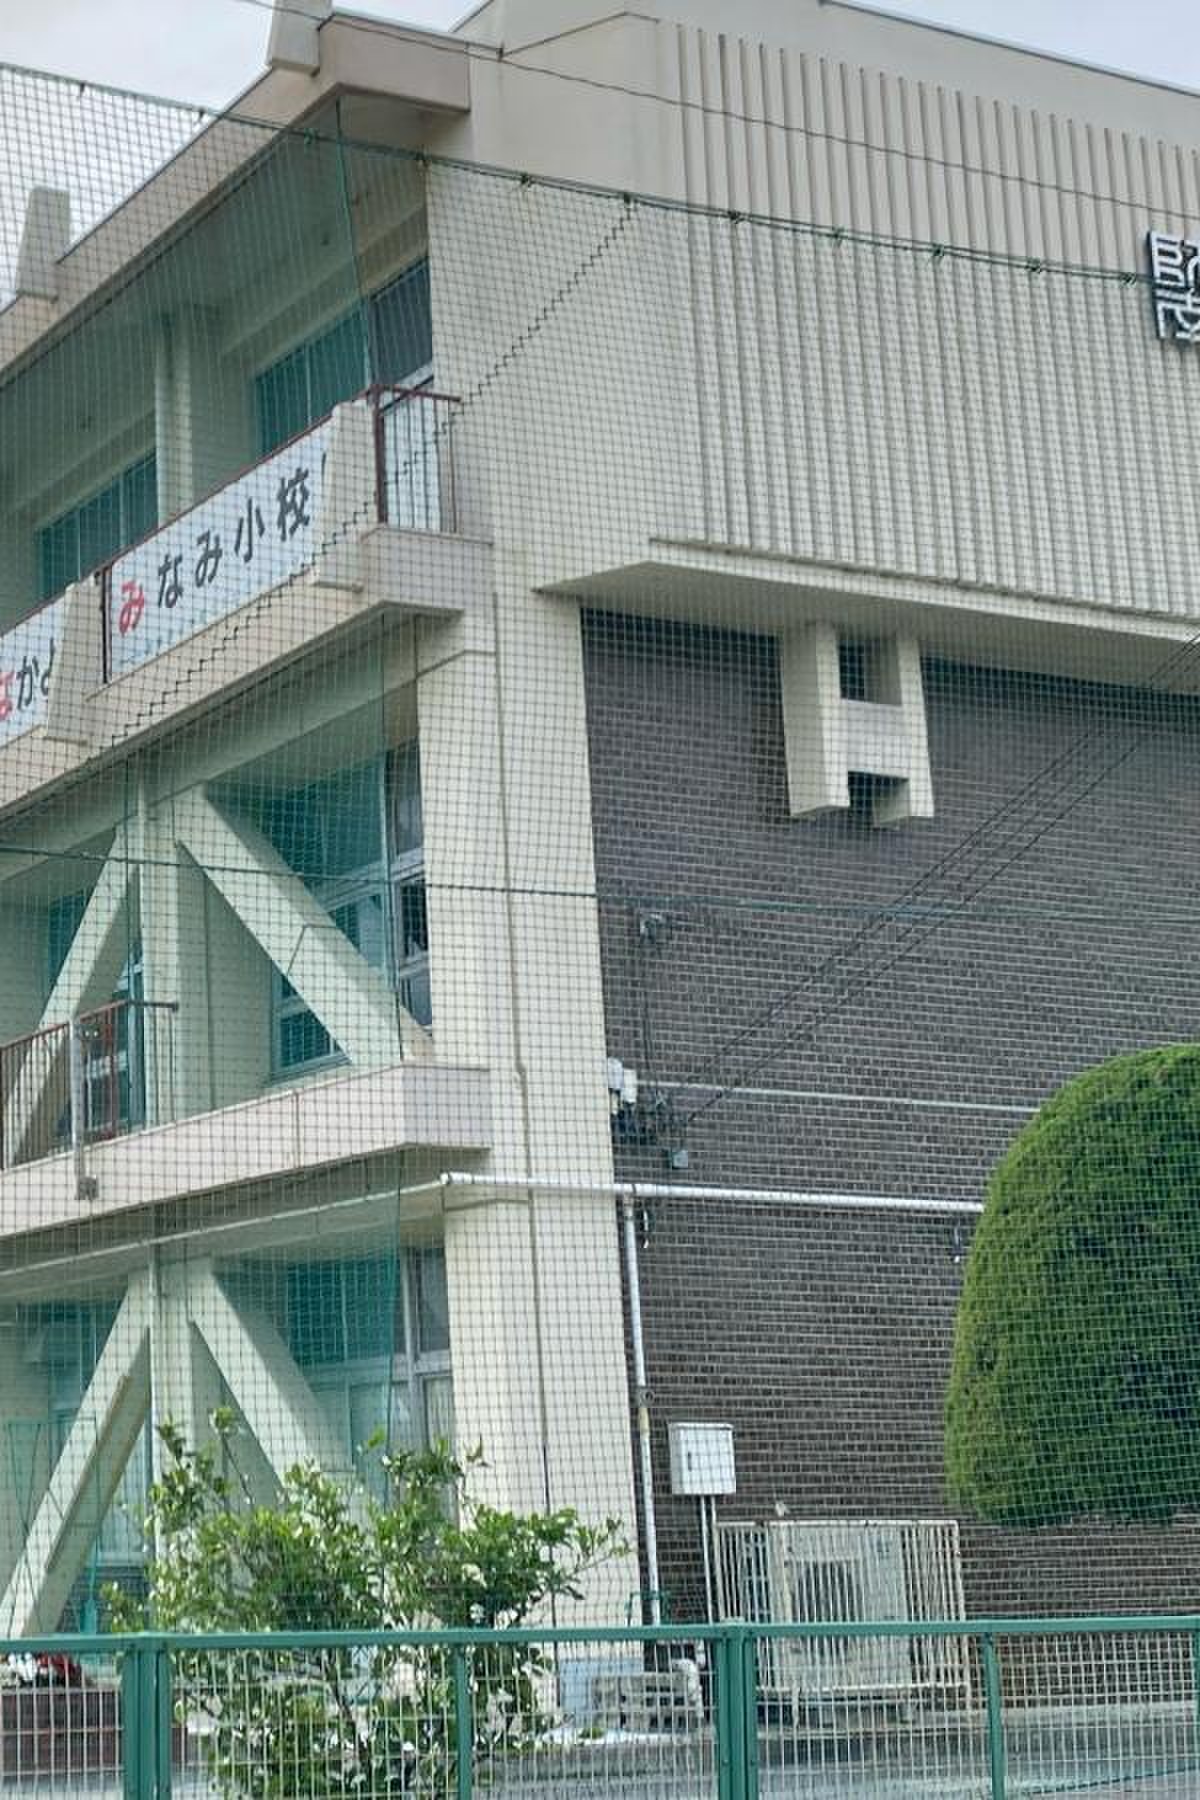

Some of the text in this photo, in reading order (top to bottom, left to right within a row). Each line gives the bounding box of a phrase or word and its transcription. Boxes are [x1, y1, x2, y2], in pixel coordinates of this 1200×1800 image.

[118, 452, 326, 637] みなみ小校
